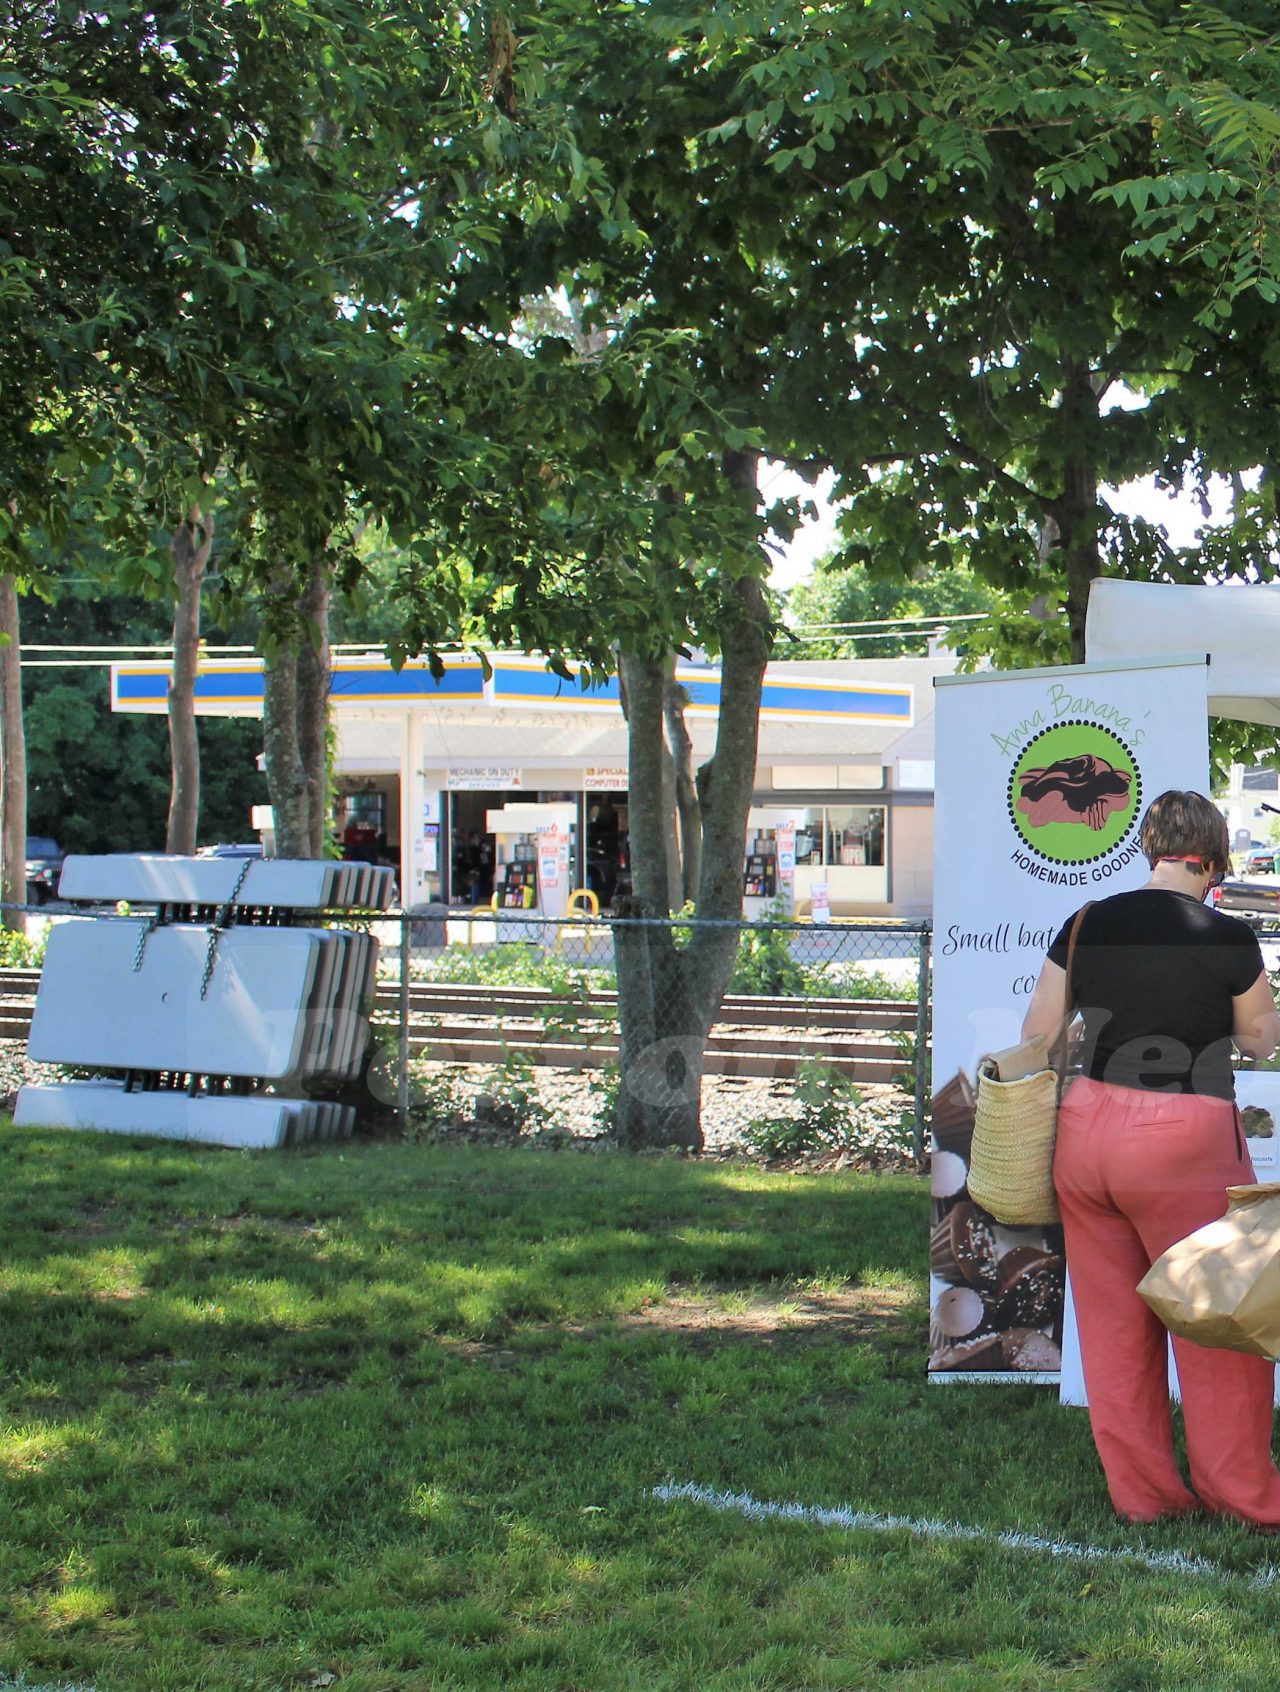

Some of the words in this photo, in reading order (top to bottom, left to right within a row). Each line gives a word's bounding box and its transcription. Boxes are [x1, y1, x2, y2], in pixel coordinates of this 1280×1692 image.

[990, 709, 1046, 758] Anna
[1046, 683, 1152, 747] Banana's
[450, 767, 486, 776] MECHANIC
[488, 767, 498, 776] ON
[500, 767, 519, 776] DUTY
[596, 767, 629, 776] SPECIAL
[584, 778, 619, 788] COMPUTER
[1010, 848, 1088, 886] HOMEMADE
[1091, 830, 1141, 882] GOODNE
[942, 922, 1010, 956] Small
[1018, 921, 1056, 950] bat
[1012, 974, 1037, 995] co
